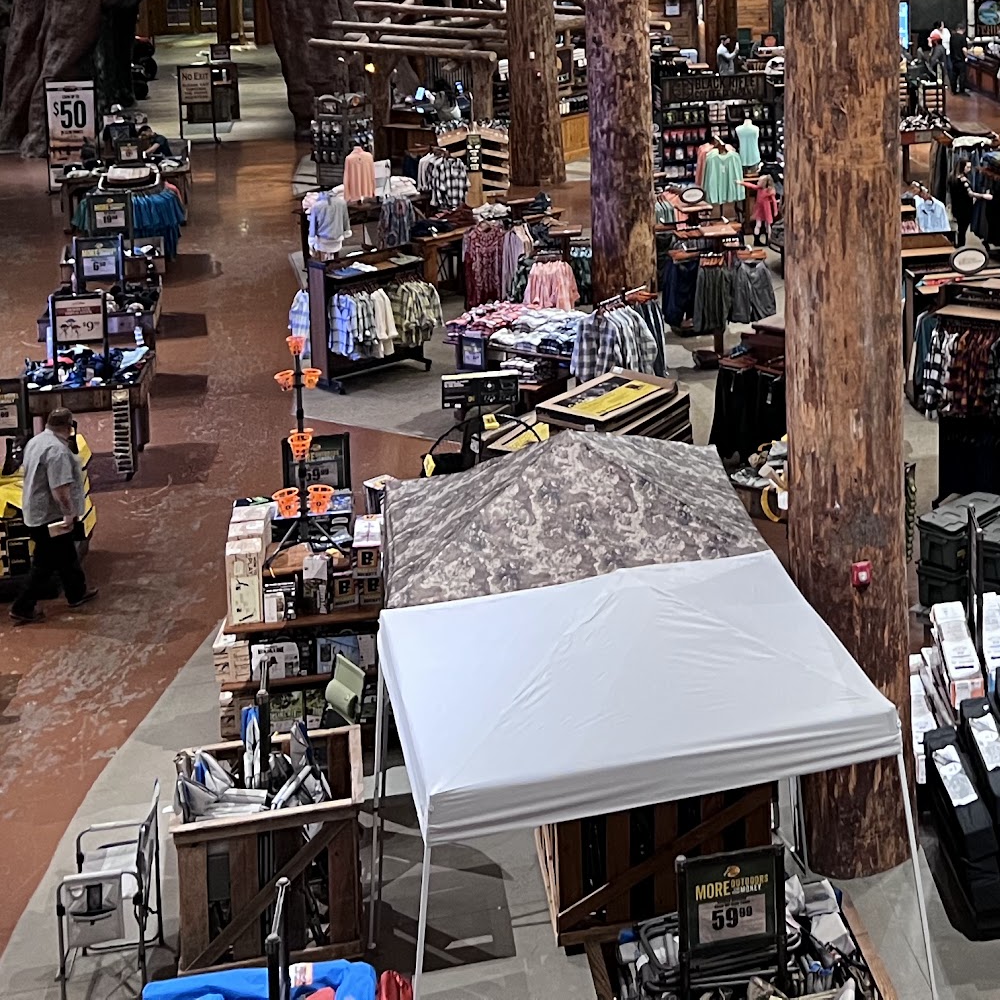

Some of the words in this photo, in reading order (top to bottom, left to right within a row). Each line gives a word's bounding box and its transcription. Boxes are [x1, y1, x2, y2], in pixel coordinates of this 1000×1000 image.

[182, 72, 193, 81] NO
[194, 72, 209, 80] EXIT
[53, 100, 87, 129] $50
[695, 880, 731, 901] MORE
[730, 873, 769, 888] OUTDOORS
[740, 884, 763, 893] MONEY
